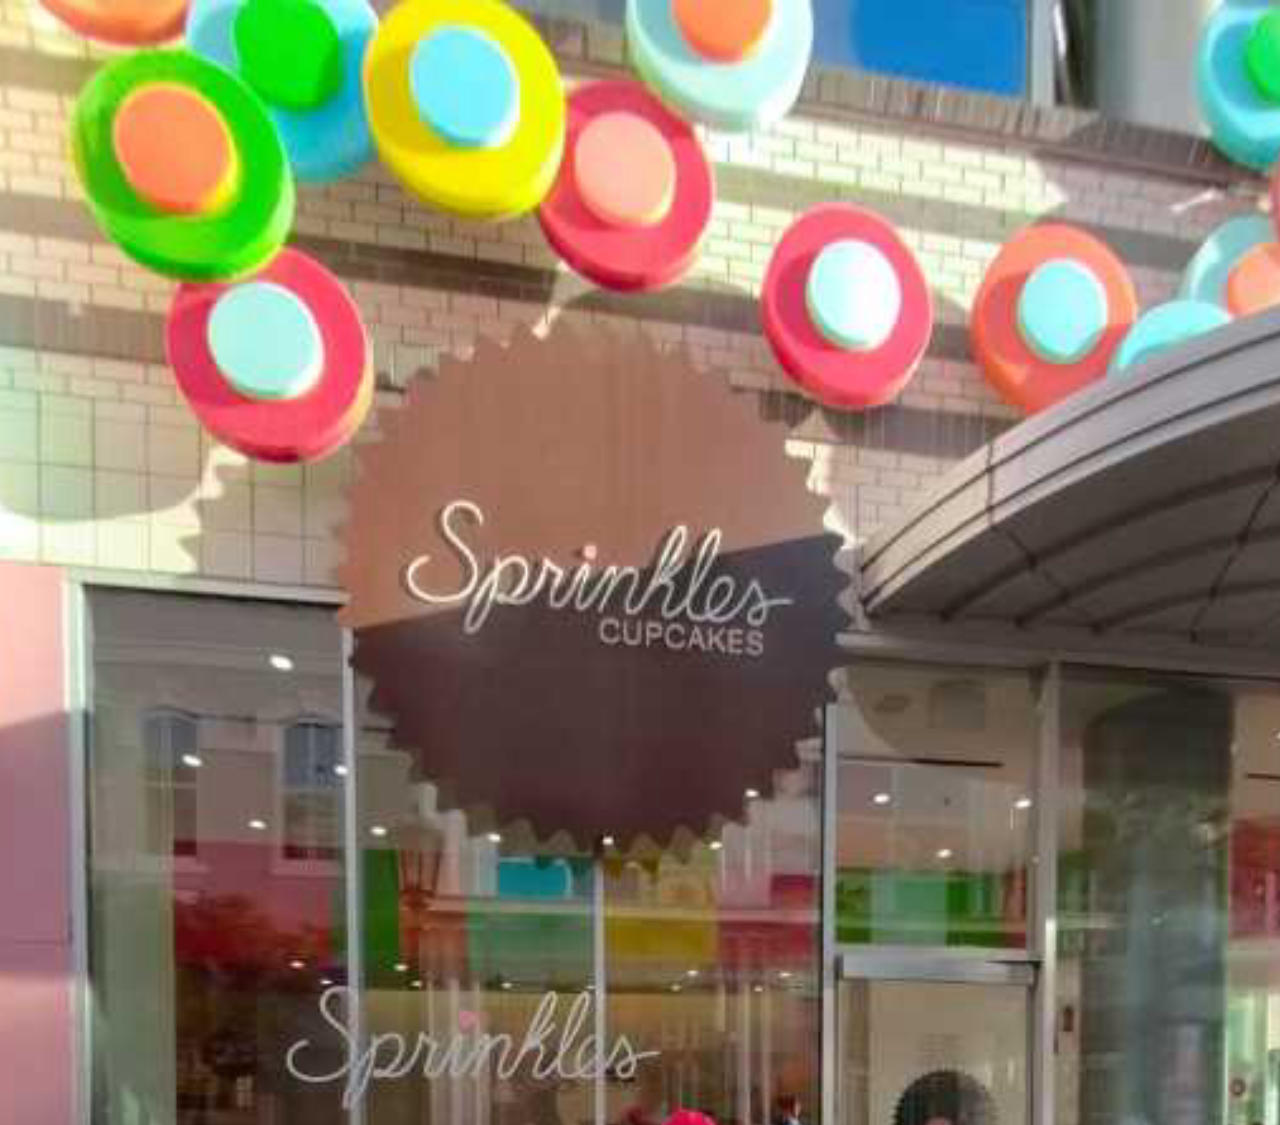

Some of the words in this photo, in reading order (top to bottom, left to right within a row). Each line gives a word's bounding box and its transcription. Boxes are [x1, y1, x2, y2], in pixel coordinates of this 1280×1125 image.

[406, 499, 793, 635] Sprinkles
[599, 617, 765, 656] CUPCAKES
[286, 984, 662, 1110] Sprinkles
